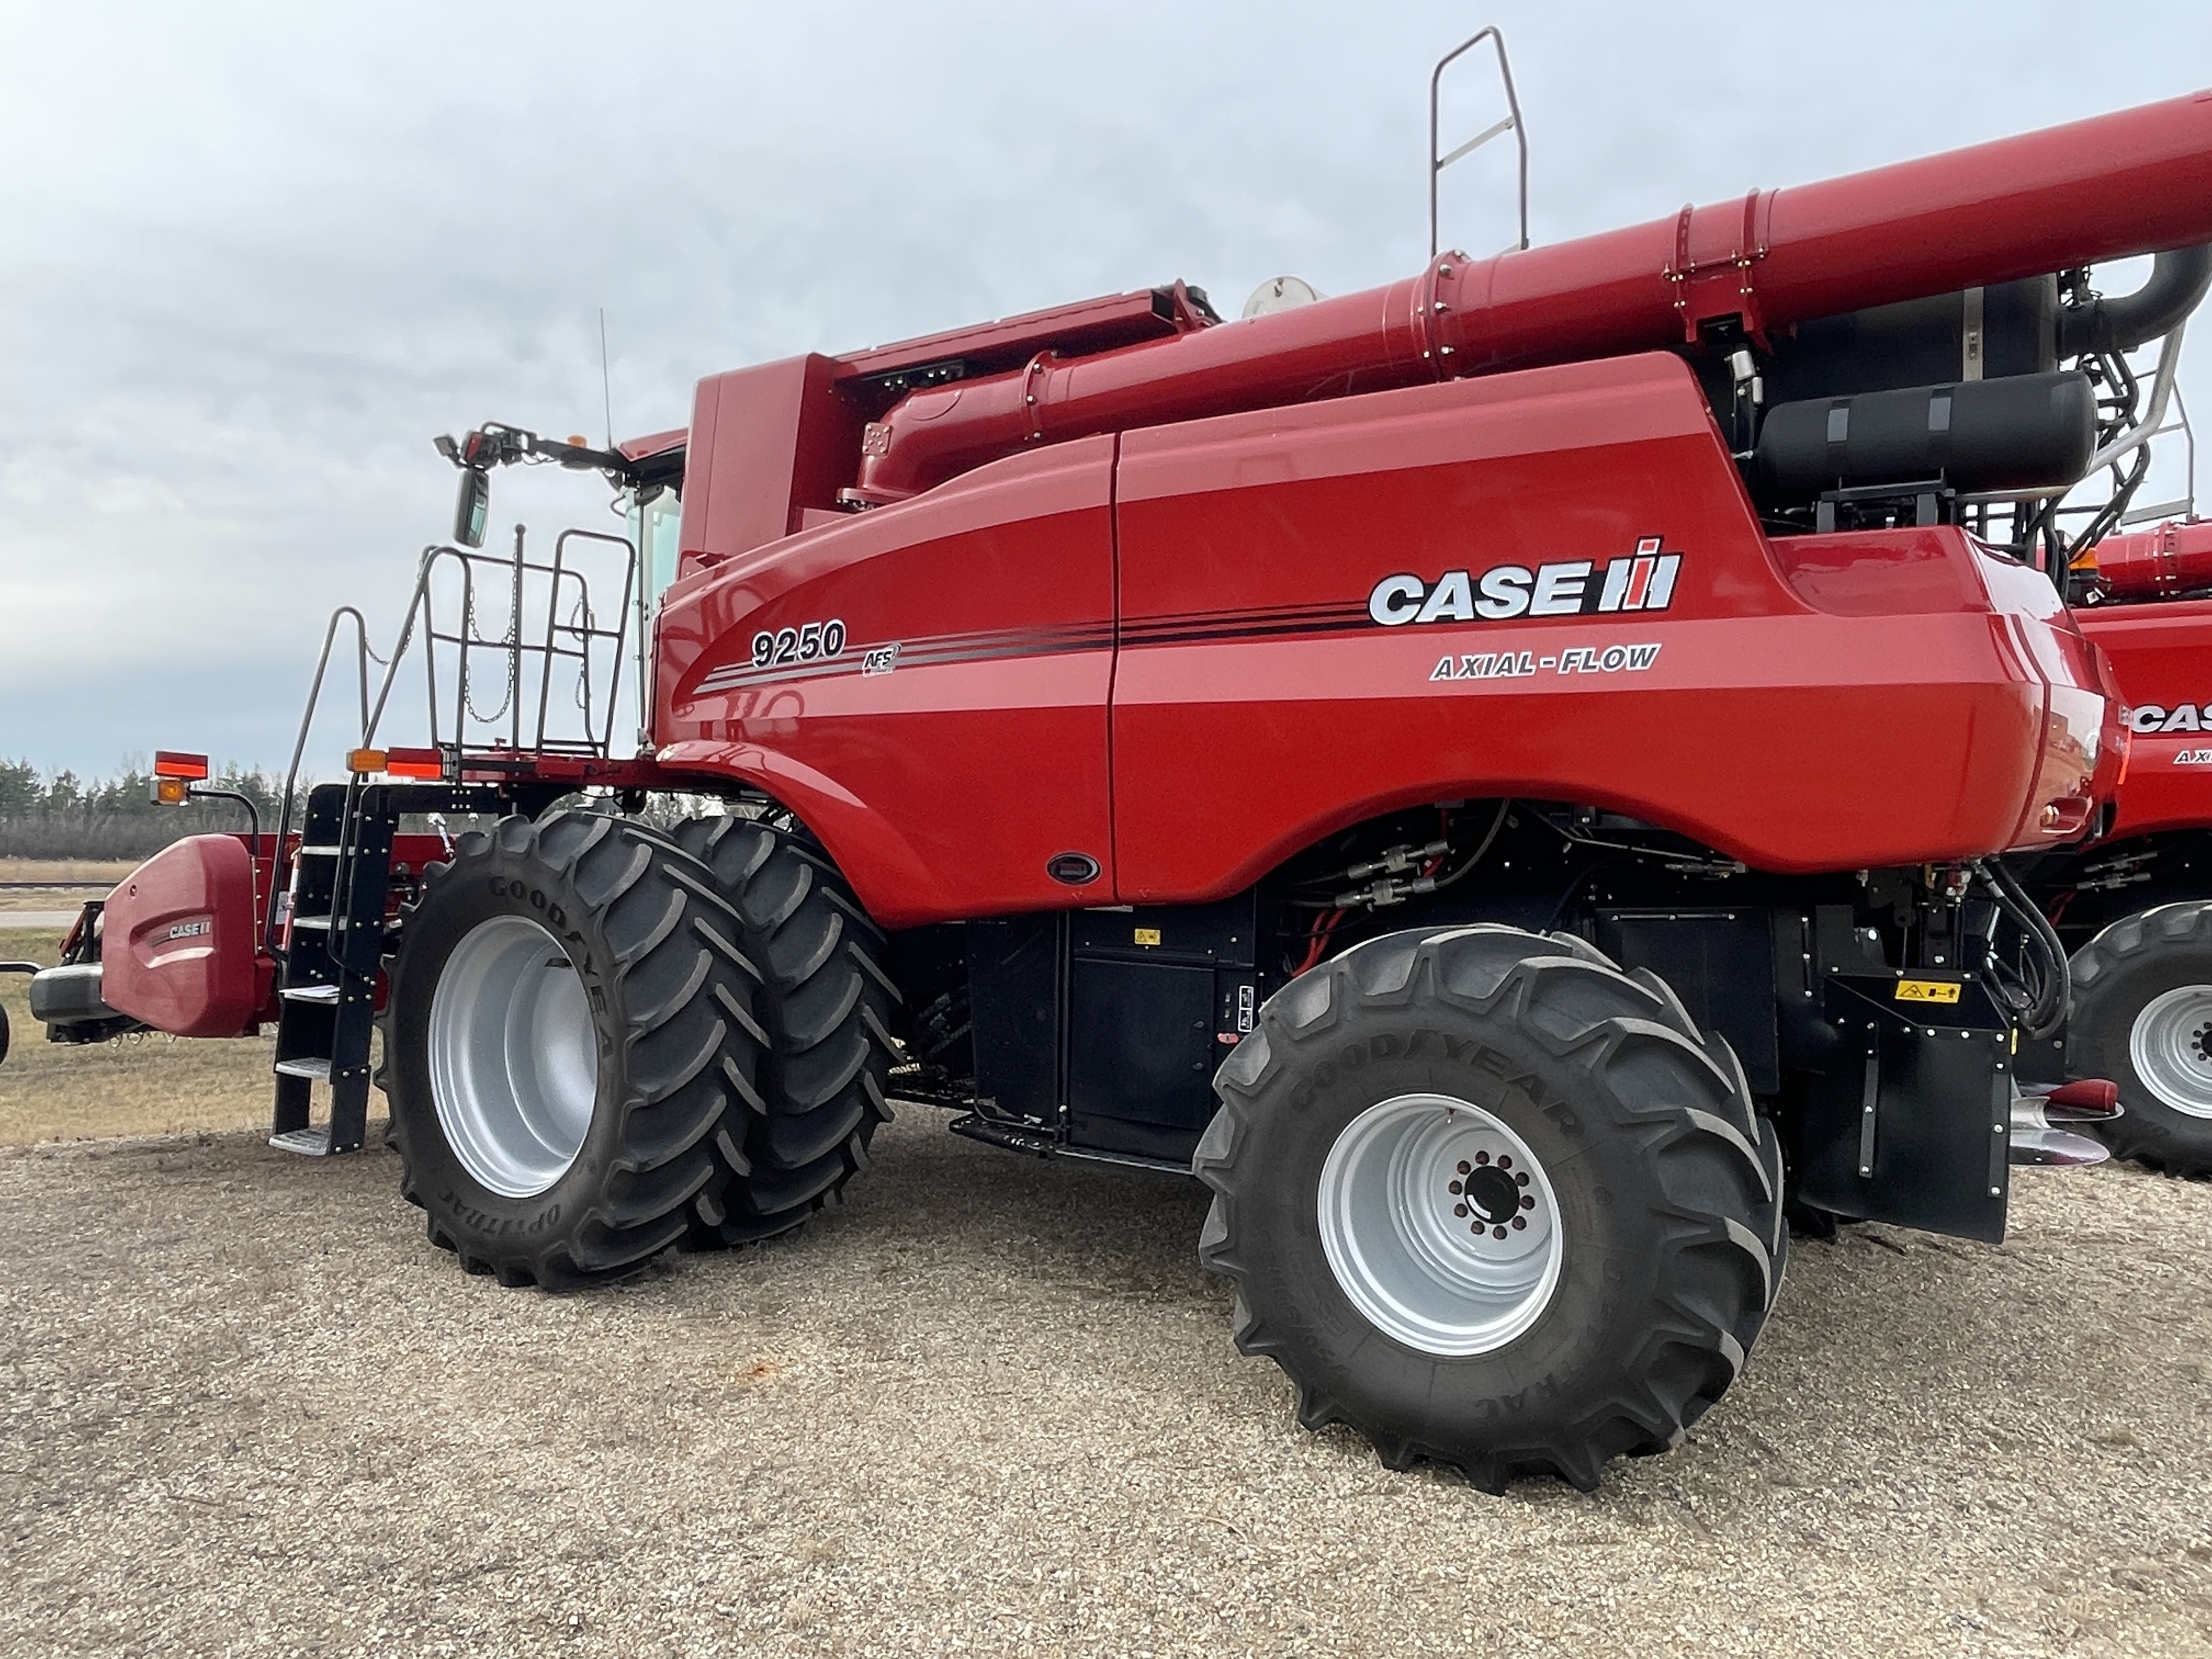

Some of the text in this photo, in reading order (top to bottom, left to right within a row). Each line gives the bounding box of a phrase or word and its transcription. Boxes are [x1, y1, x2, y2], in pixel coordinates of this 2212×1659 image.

[1369, 562, 1592, 626] CASE
[752, 619, 847, 668] 9250
[863, 649, 894, 669] AFS
[1429, 644, 1662, 681] AXIAL-FLOW
[170, 923, 200, 938] CASE
[1289, 1029, 1586, 1139] GOODYEAR
